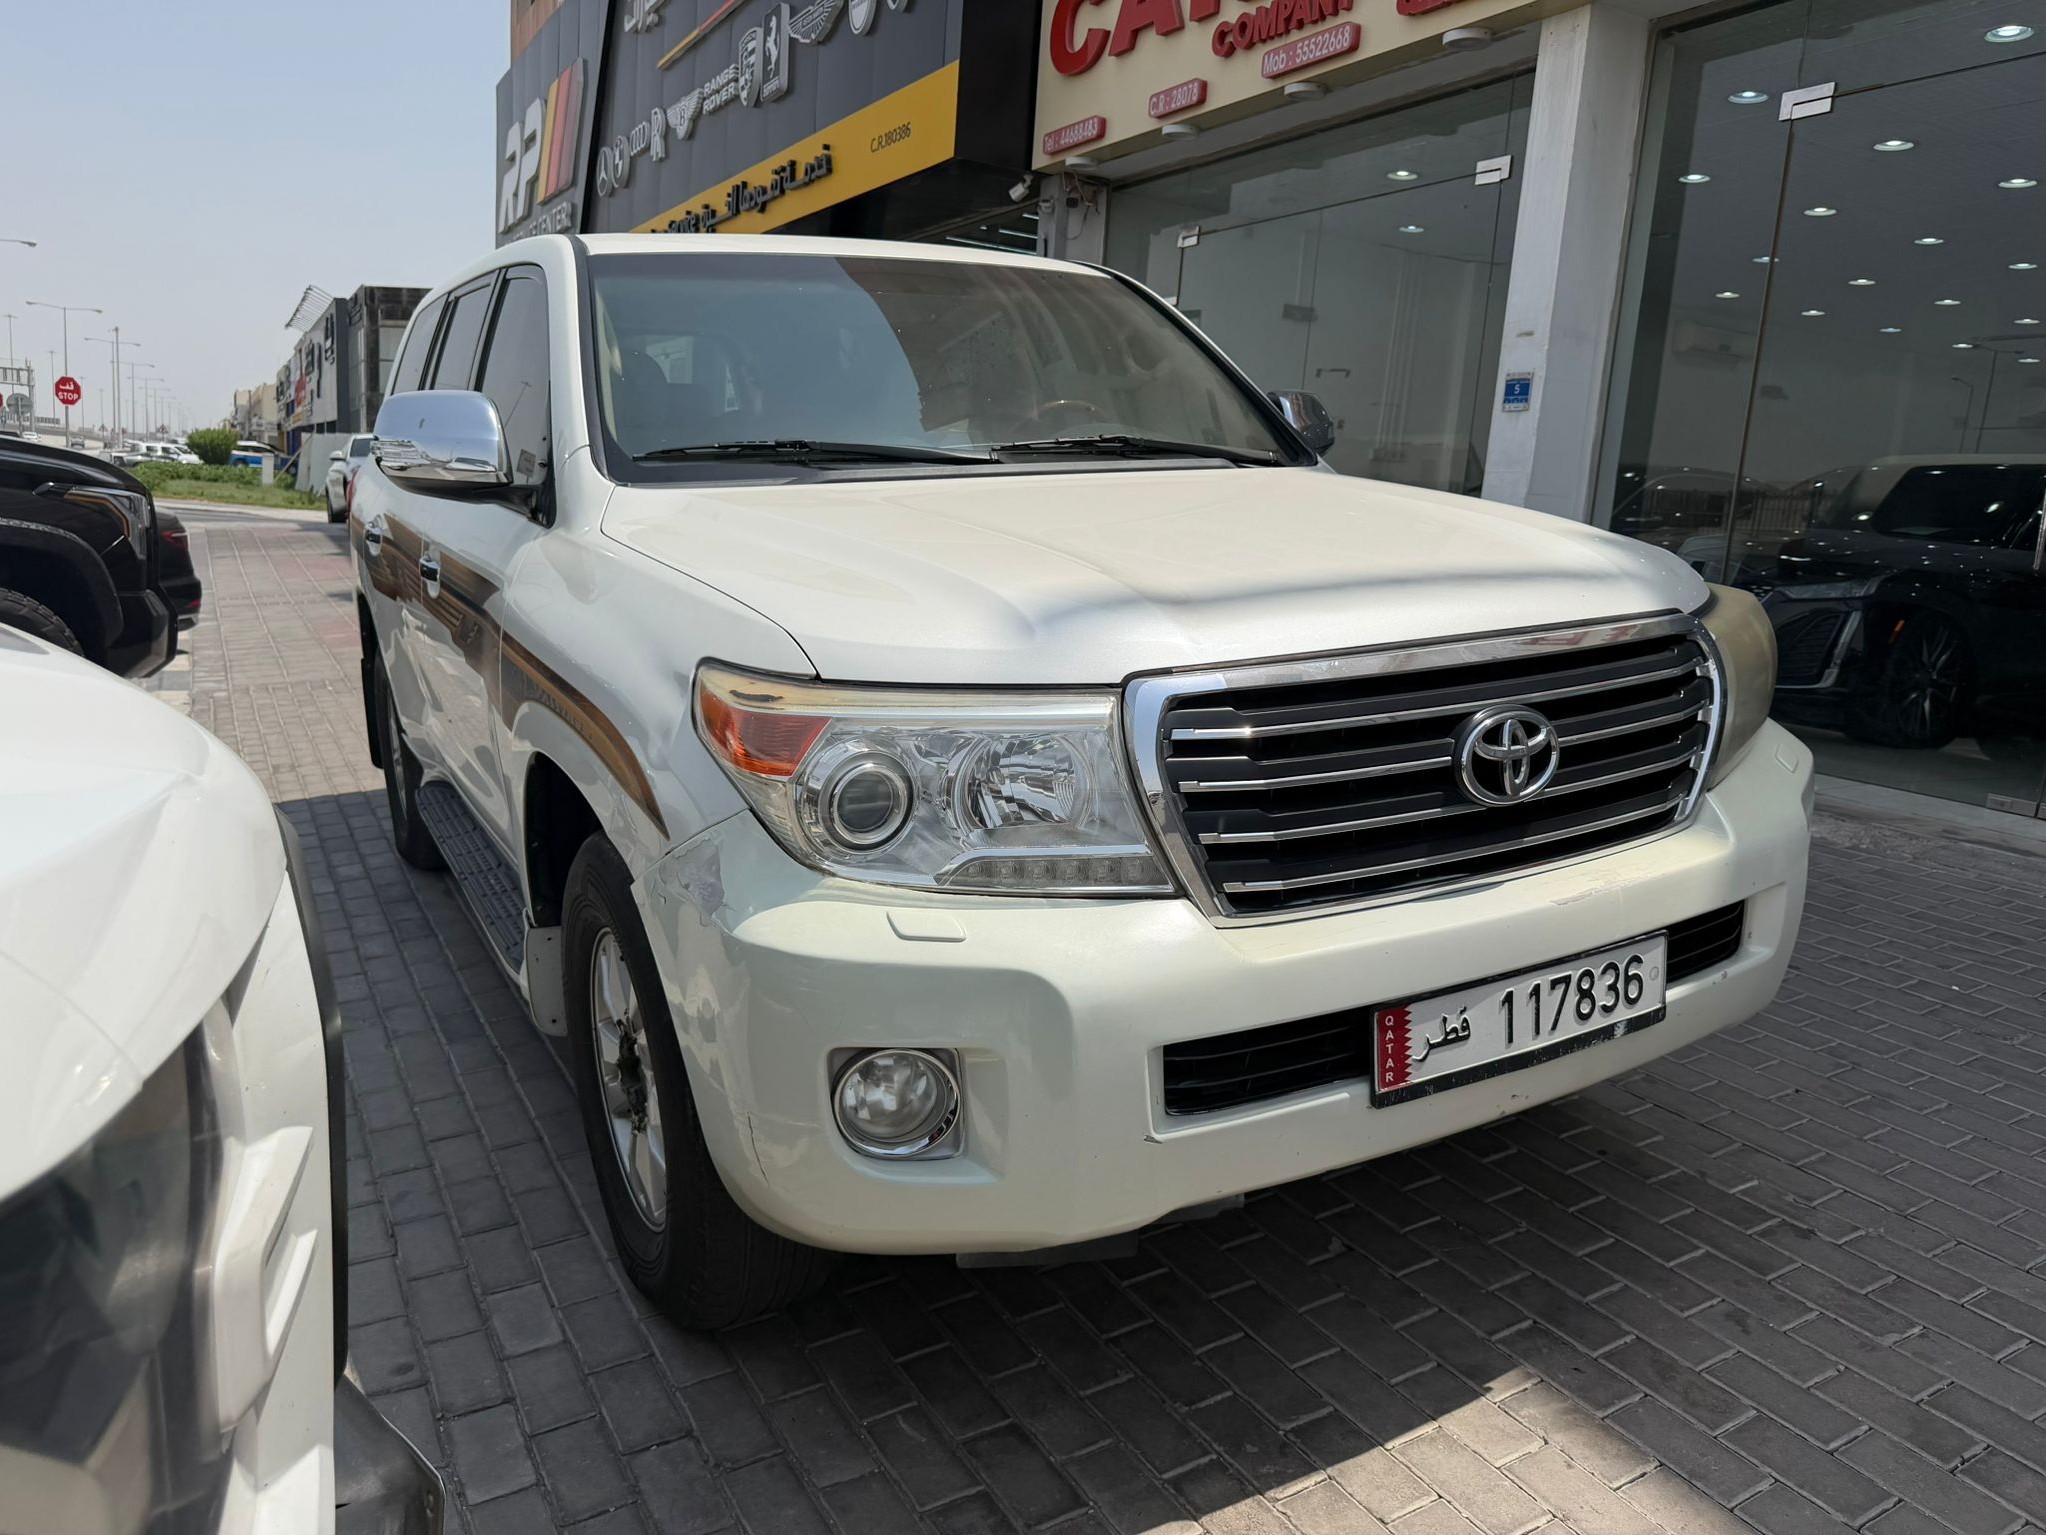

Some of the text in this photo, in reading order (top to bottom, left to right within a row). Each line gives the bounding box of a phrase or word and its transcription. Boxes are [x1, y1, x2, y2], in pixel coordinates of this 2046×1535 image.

[1295, 25, 1350, 63] 55522668
[703, 63, 737, 97] RANGE
[1171, 82, 1199, 108] 28078
[702, 82, 738, 115] ROVER
[57, 391, 79, 401] STOP
[60, 381, 75, 391] قف
[1514, 383, 1520, 395] 5
[1501, 953, 1645, 1044] 117836
[1384, 1014, 1395, 1083] QATAR
[1411, 1004, 1471, 1062] قطر
